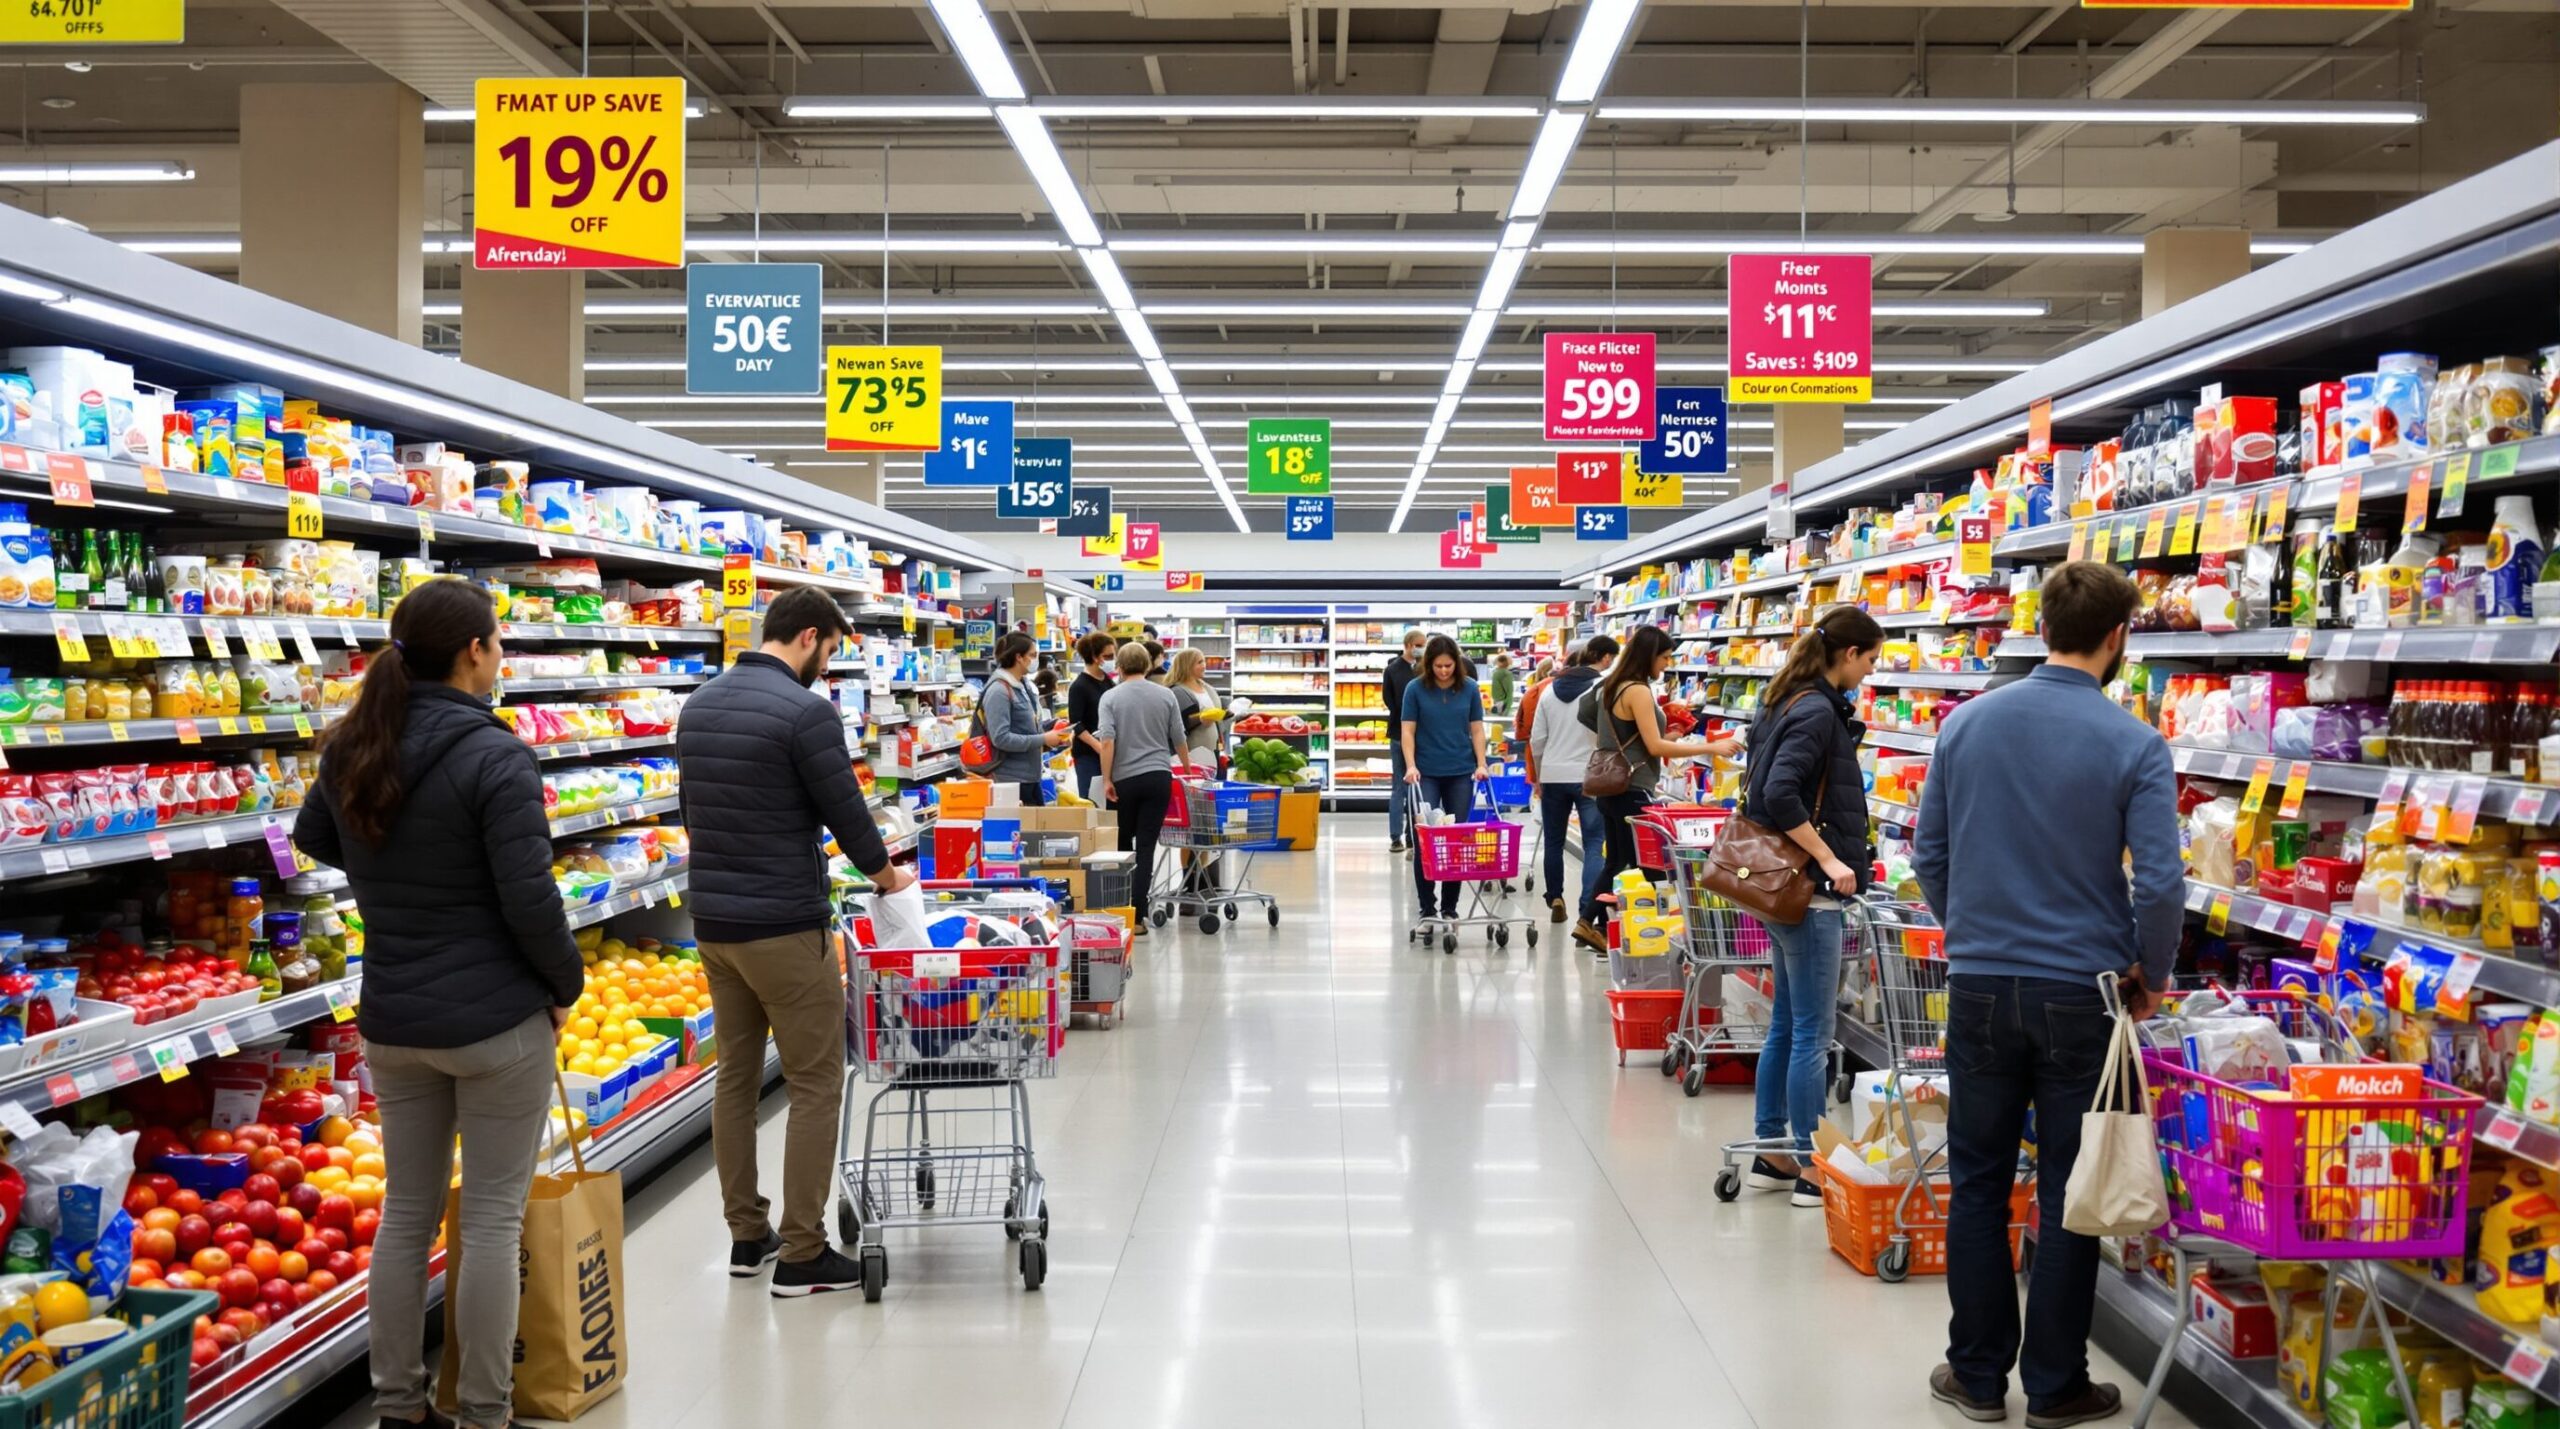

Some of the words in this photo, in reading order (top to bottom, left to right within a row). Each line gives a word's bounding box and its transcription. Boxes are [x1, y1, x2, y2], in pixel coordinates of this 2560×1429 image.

[496, 94, 558, 112] FMAT
[565, 94, 596, 112] UP
[604, 94, 663, 112] SAVE
[498, 135, 669, 209] 19%
[570, 217, 609, 233] OFF
[712, 315, 793, 353] 50€
[891, 357, 924, 370] Save
[1609, 361, 1625, 373] to
[1561, 378, 1641, 420] 599
[869, 421, 895, 433] OFF
[954, 413, 990, 425] Mave
[1664, 431, 1715, 457] 50%
